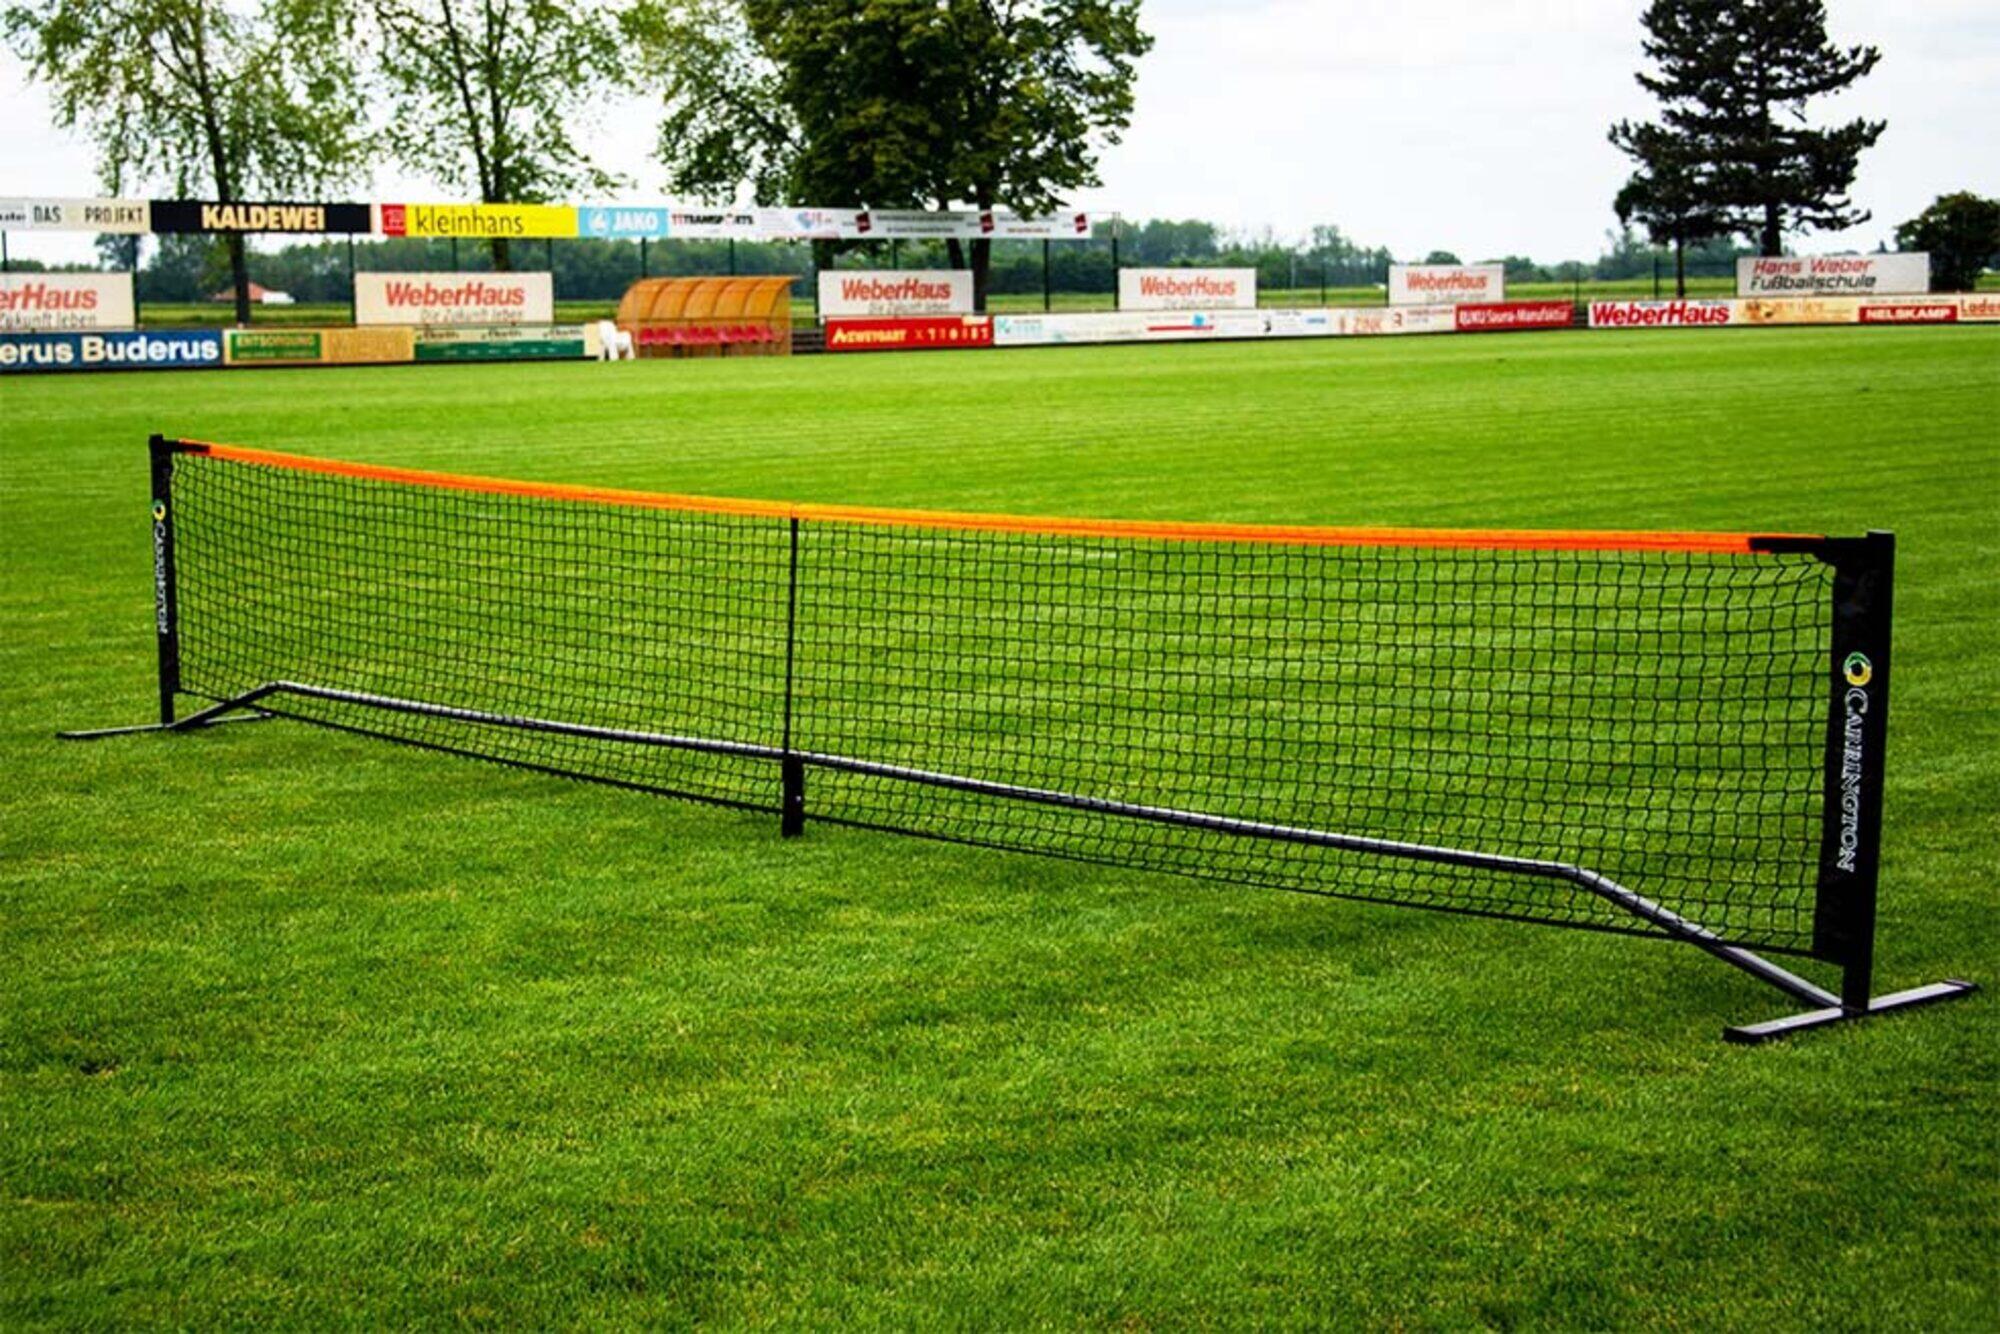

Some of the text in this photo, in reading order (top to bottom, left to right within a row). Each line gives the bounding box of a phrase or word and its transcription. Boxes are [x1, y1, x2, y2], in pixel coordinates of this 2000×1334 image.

[33, 206, 62, 222] DAS
[85, 206, 144, 223] PROJEKT
[201, 204, 327, 231] KALDEWEI
[415, 206, 525, 234] kleinhans
[612, 212, 658, 231] JAKO
[1753, 256, 1875, 275] Hans Weber
[842, 278, 952, 301] WeberHaus
[1140, 276, 1236, 296] WeberHaus
[1407, 271, 1488, 291] WeberHaus
[1749, 273, 1878, 293] Fußballschule
[385, 280, 525, 306] WeberHaus
[1591, 300, 1731, 327] WeberHaus
[1865, 307, 1952, 320] NELSKAMP
[81, 335, 219, 362] Buderus
